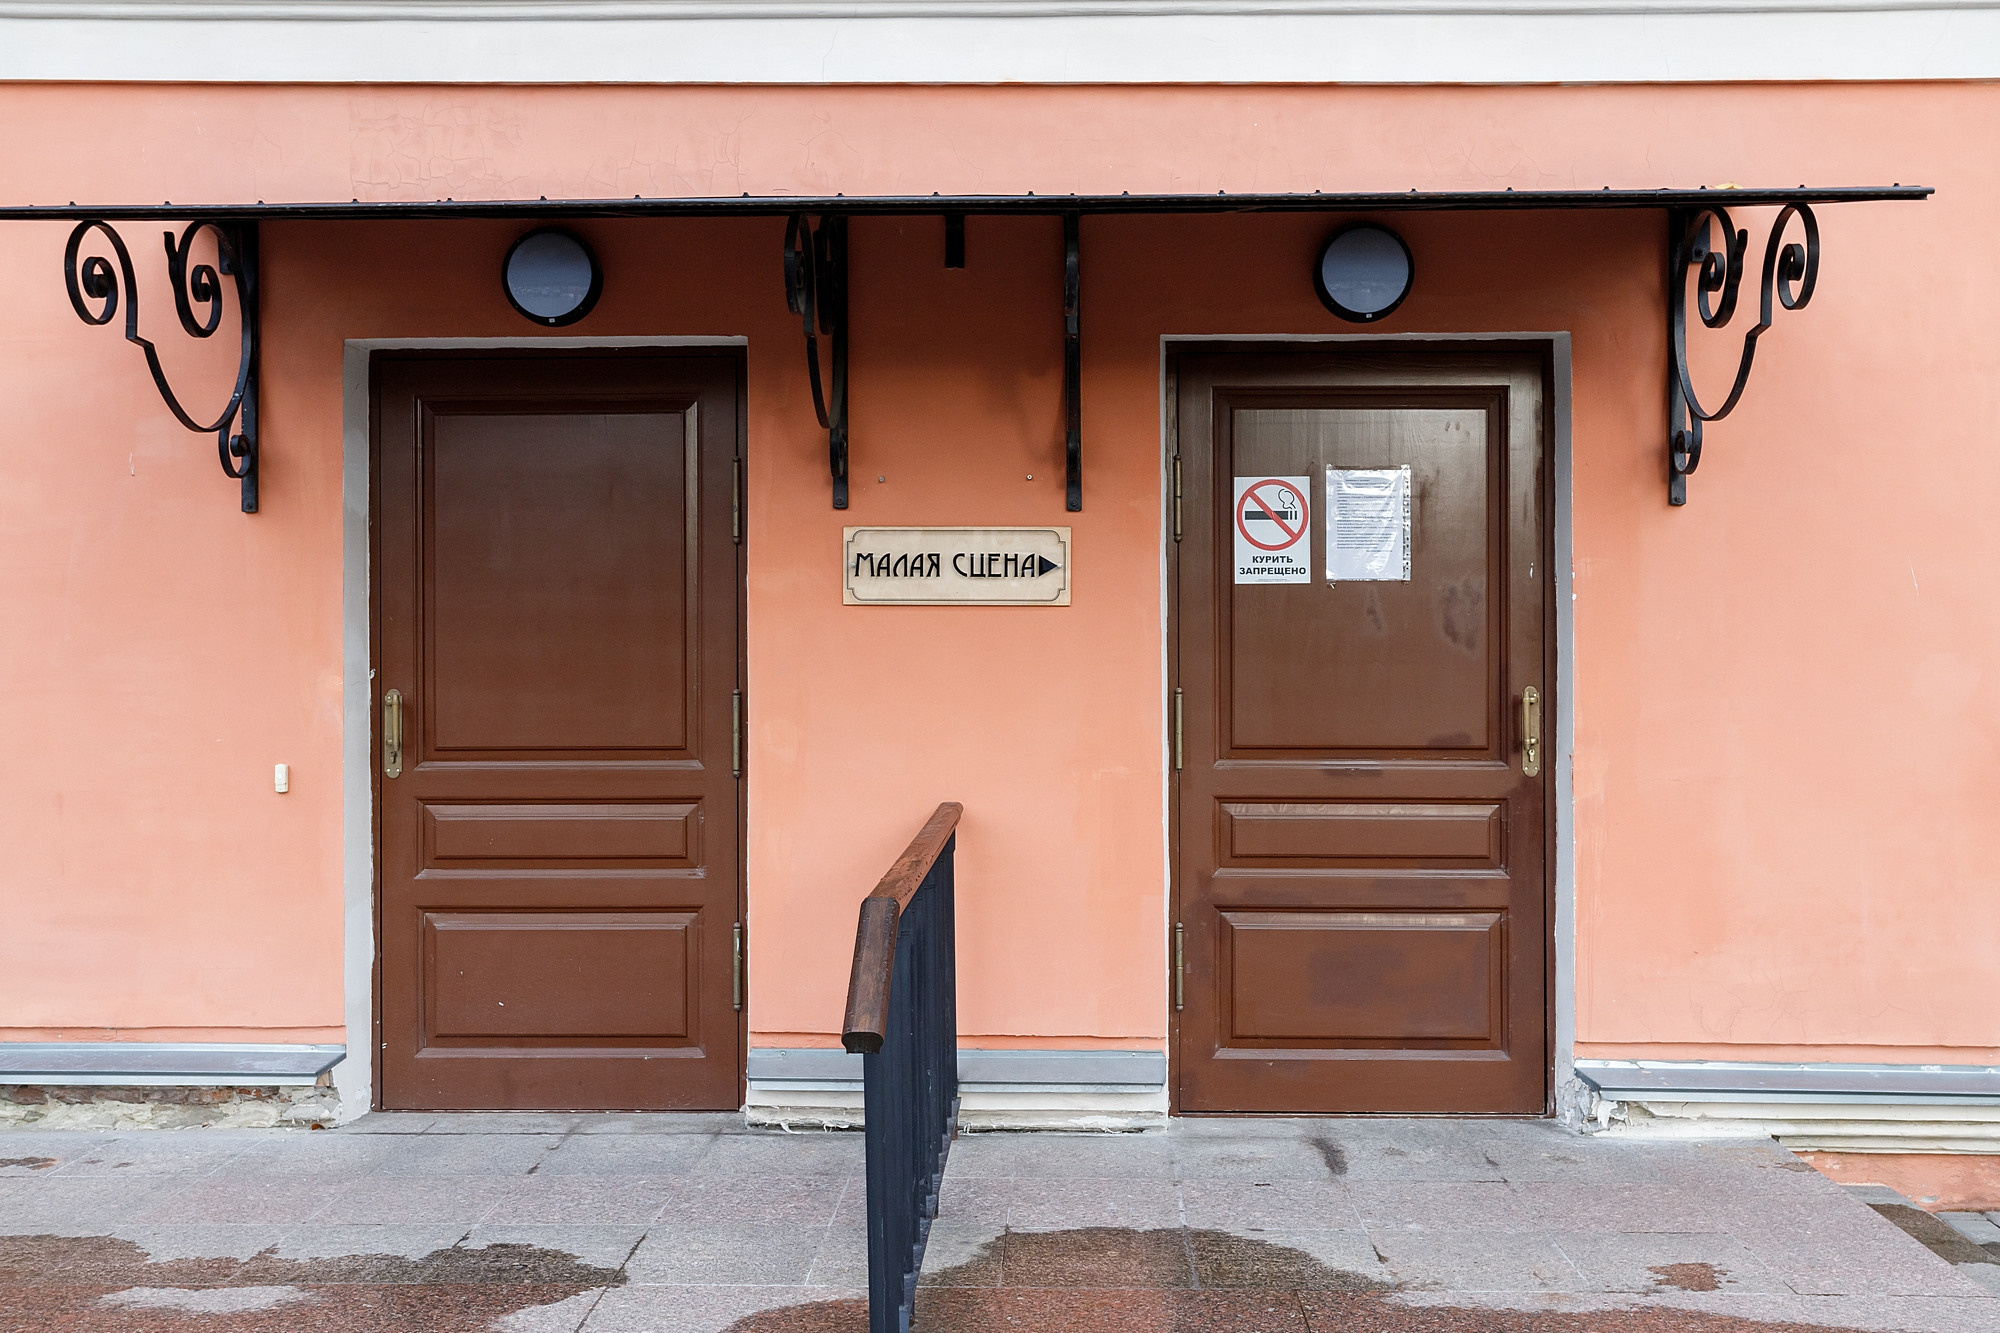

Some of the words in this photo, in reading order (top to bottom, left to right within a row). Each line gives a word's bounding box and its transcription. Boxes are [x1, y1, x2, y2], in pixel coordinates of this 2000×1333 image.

[1252, 555, 1294, 564] КУРИТЬ
[854, 552, 940, 577] МАЛАЯ
[952, 552, 1036, 577] СЦЕНА
[1239, 567, 1307, 576] ЗАПРЕЩЕНО
